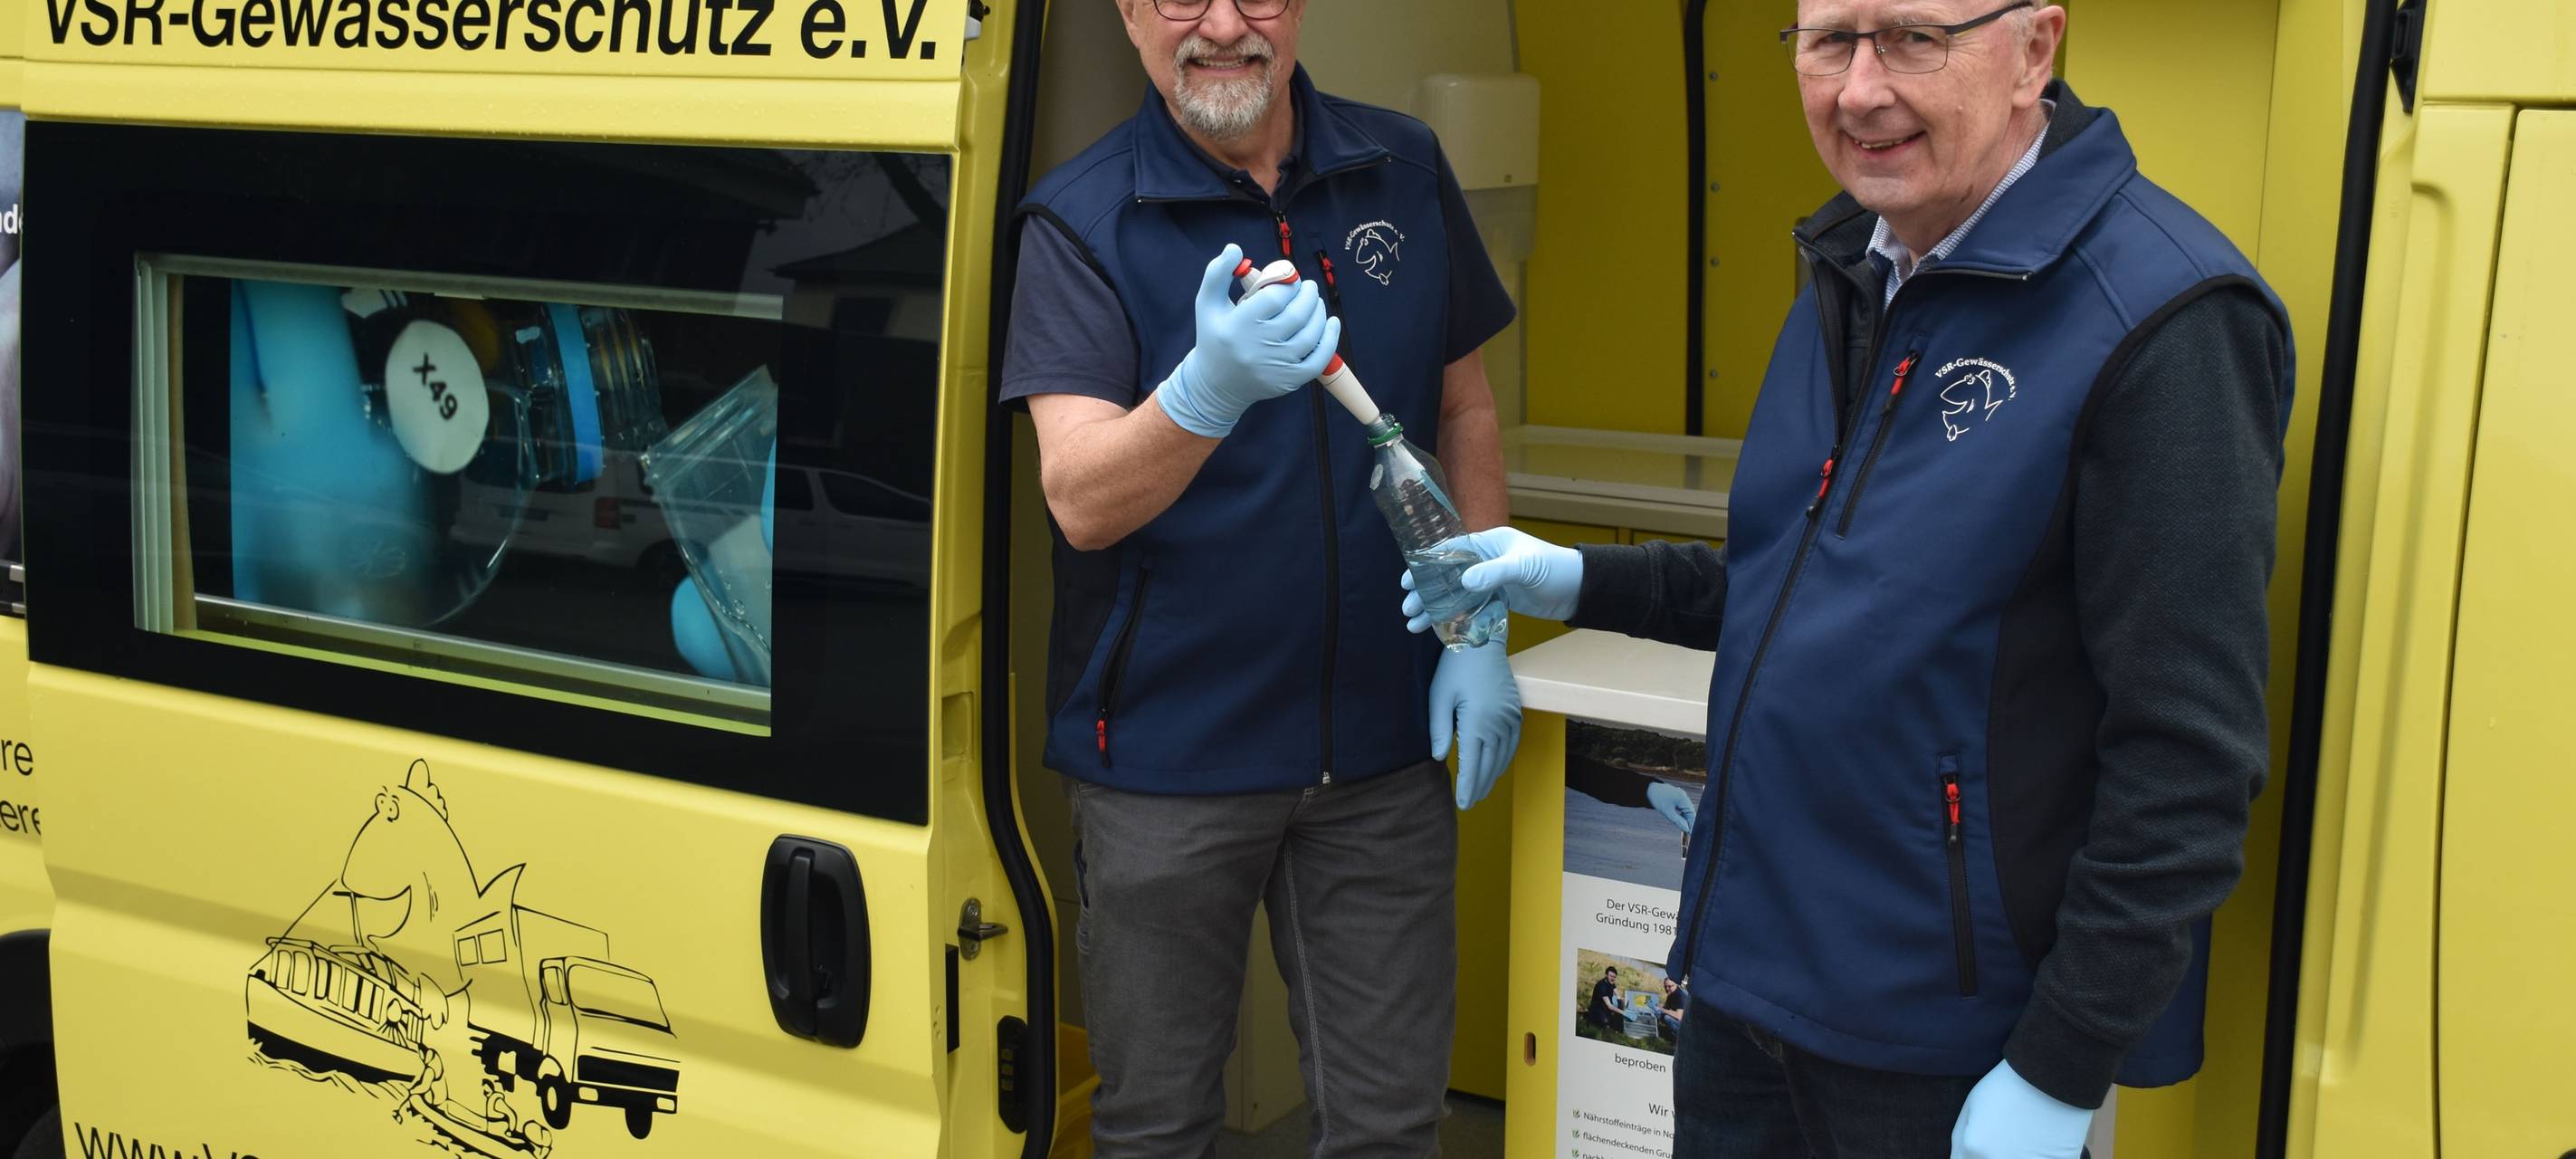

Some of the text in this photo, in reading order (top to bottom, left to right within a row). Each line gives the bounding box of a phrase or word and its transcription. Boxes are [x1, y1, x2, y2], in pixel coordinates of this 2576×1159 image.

[800, 0, 936, 60] e.V.
[1934, 357, 2016, 387] VSR-Gewässerschutz
[412, 351, 458, 421] X49
[1607, 898, 1626, 911] Der
[1596, 912, 1650, 934] Gründung
[1615, 1052, 1666, 1073] beproben
[1648, 1102, 1669, 1116] Wir
[1583, 1112, 1652, 1135] Nährstoffeinträge
[1582, 1132, 1673, 1159] flächendeckenden Gru
